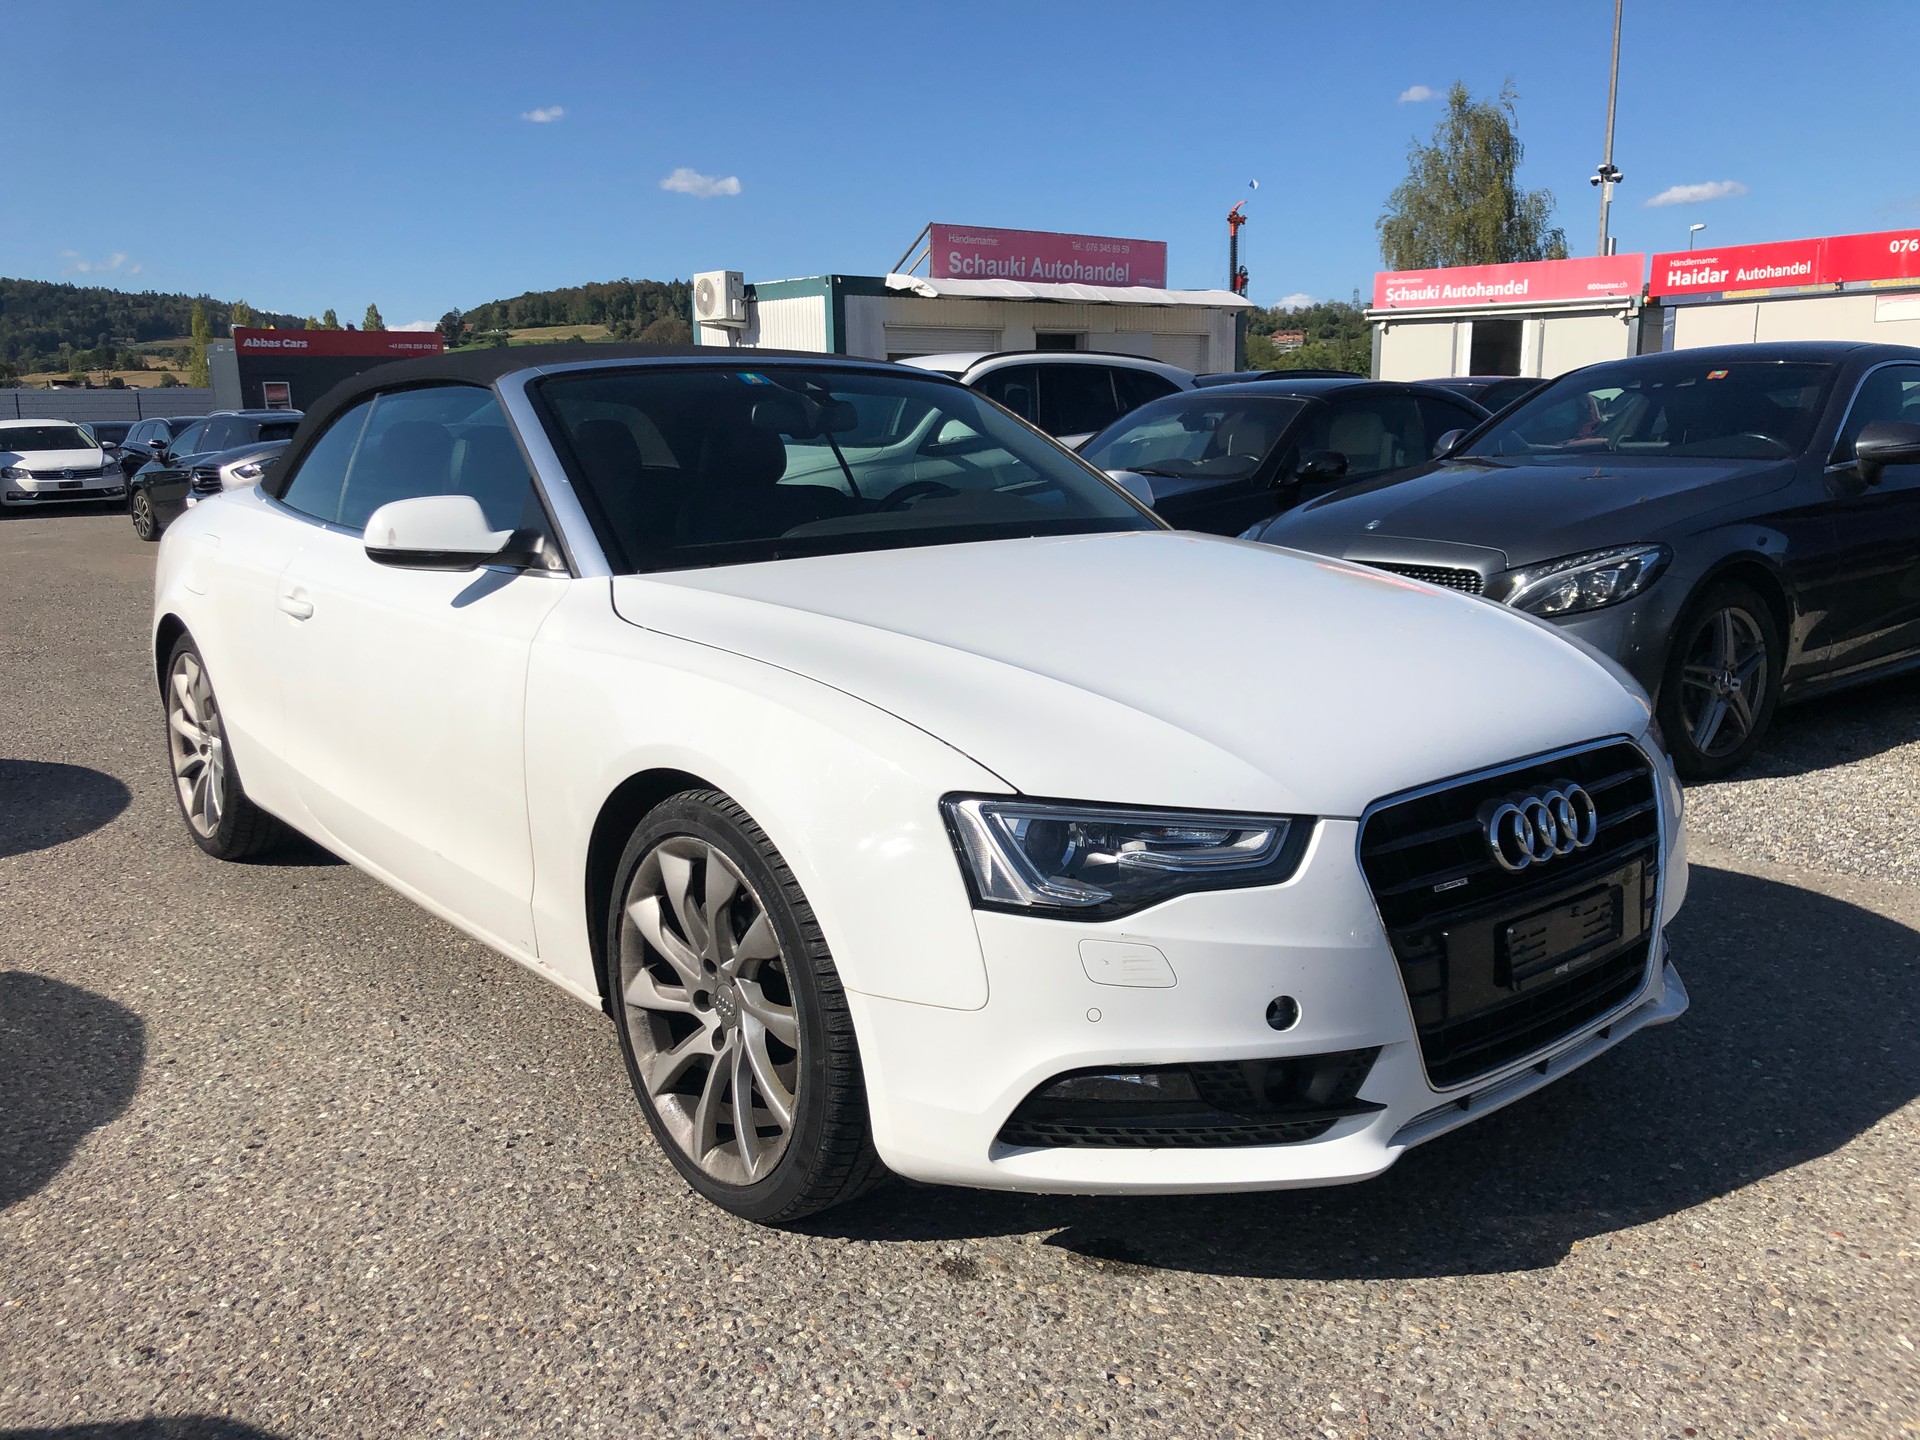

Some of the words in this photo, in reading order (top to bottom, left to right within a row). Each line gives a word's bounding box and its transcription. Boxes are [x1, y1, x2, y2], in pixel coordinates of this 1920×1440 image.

[948, 233, 1000, 246] Händlername:
[1889, 238, 1920, 254] 076
[949, 251, 1026, 277] Schauki
[1030, 257, 1130, 283] Autohandel
[1670, 257, 1719, 267] Händlername:
[1667, 267, 1730, 287] Haidar
[1736, 260, 1812, 282] Autohandel
[1385, 285, 1440, 302] Schauki
[1442, 278, 1529, 299] Autohandel
[243, 338, 281, 348] Abbas
[282, 338, 308, 348] Cars
